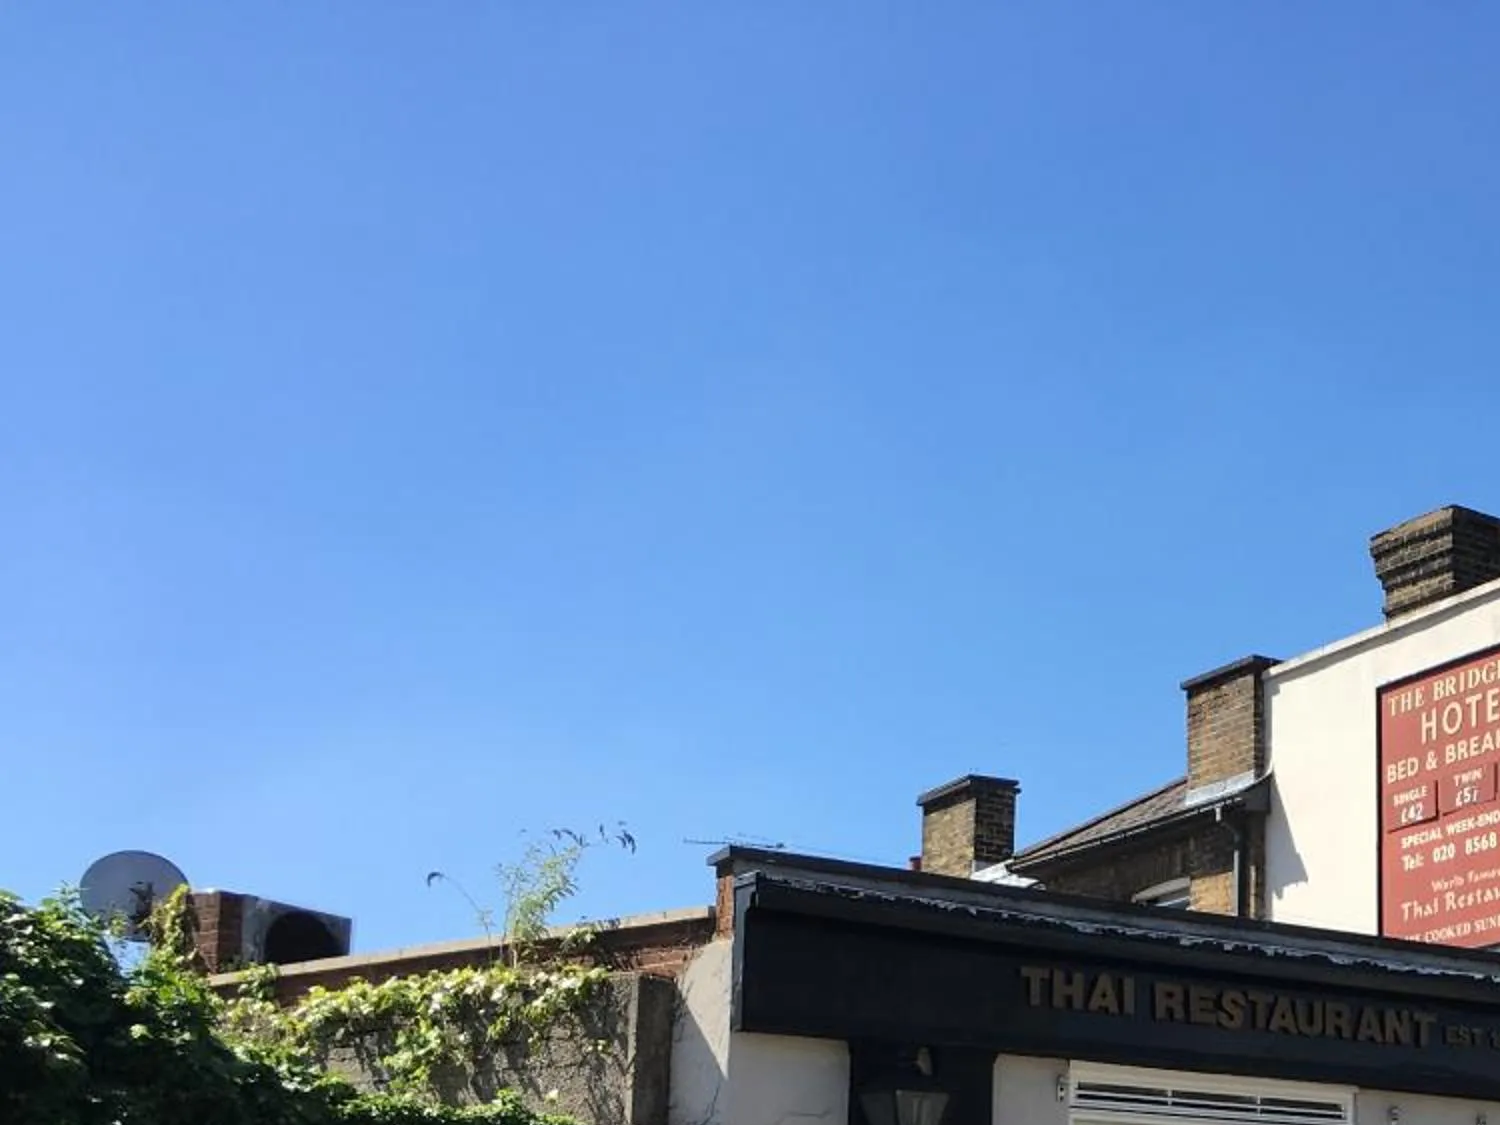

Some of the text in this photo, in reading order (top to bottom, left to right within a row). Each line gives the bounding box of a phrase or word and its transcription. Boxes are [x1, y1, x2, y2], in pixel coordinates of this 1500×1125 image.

[1389, 686, 1425, 717] THE
[1387, 757, 1419, 784] BED
[1425, 750, 1438, 771] &
[1454, 767, 1482, 787] TWIN
[1393, 785, 1429, 807] SINGLE
[1401, 826, 1443, 849] SPECIAL
[1446, 806, 1500, 836] WEEK-END
[1433, 843, 1456, 863] 020
[1465, 832, 1497, 855] 8568
[1401, 893, 1439, 922] Thai
[1424, 922, 1471, 943] COOKED
[1019, 966, 1135, 1017] THAI
[1153, 984, 1438, 1048] RESTAURANT
[1444, 1025, 1482, 1047] EST
